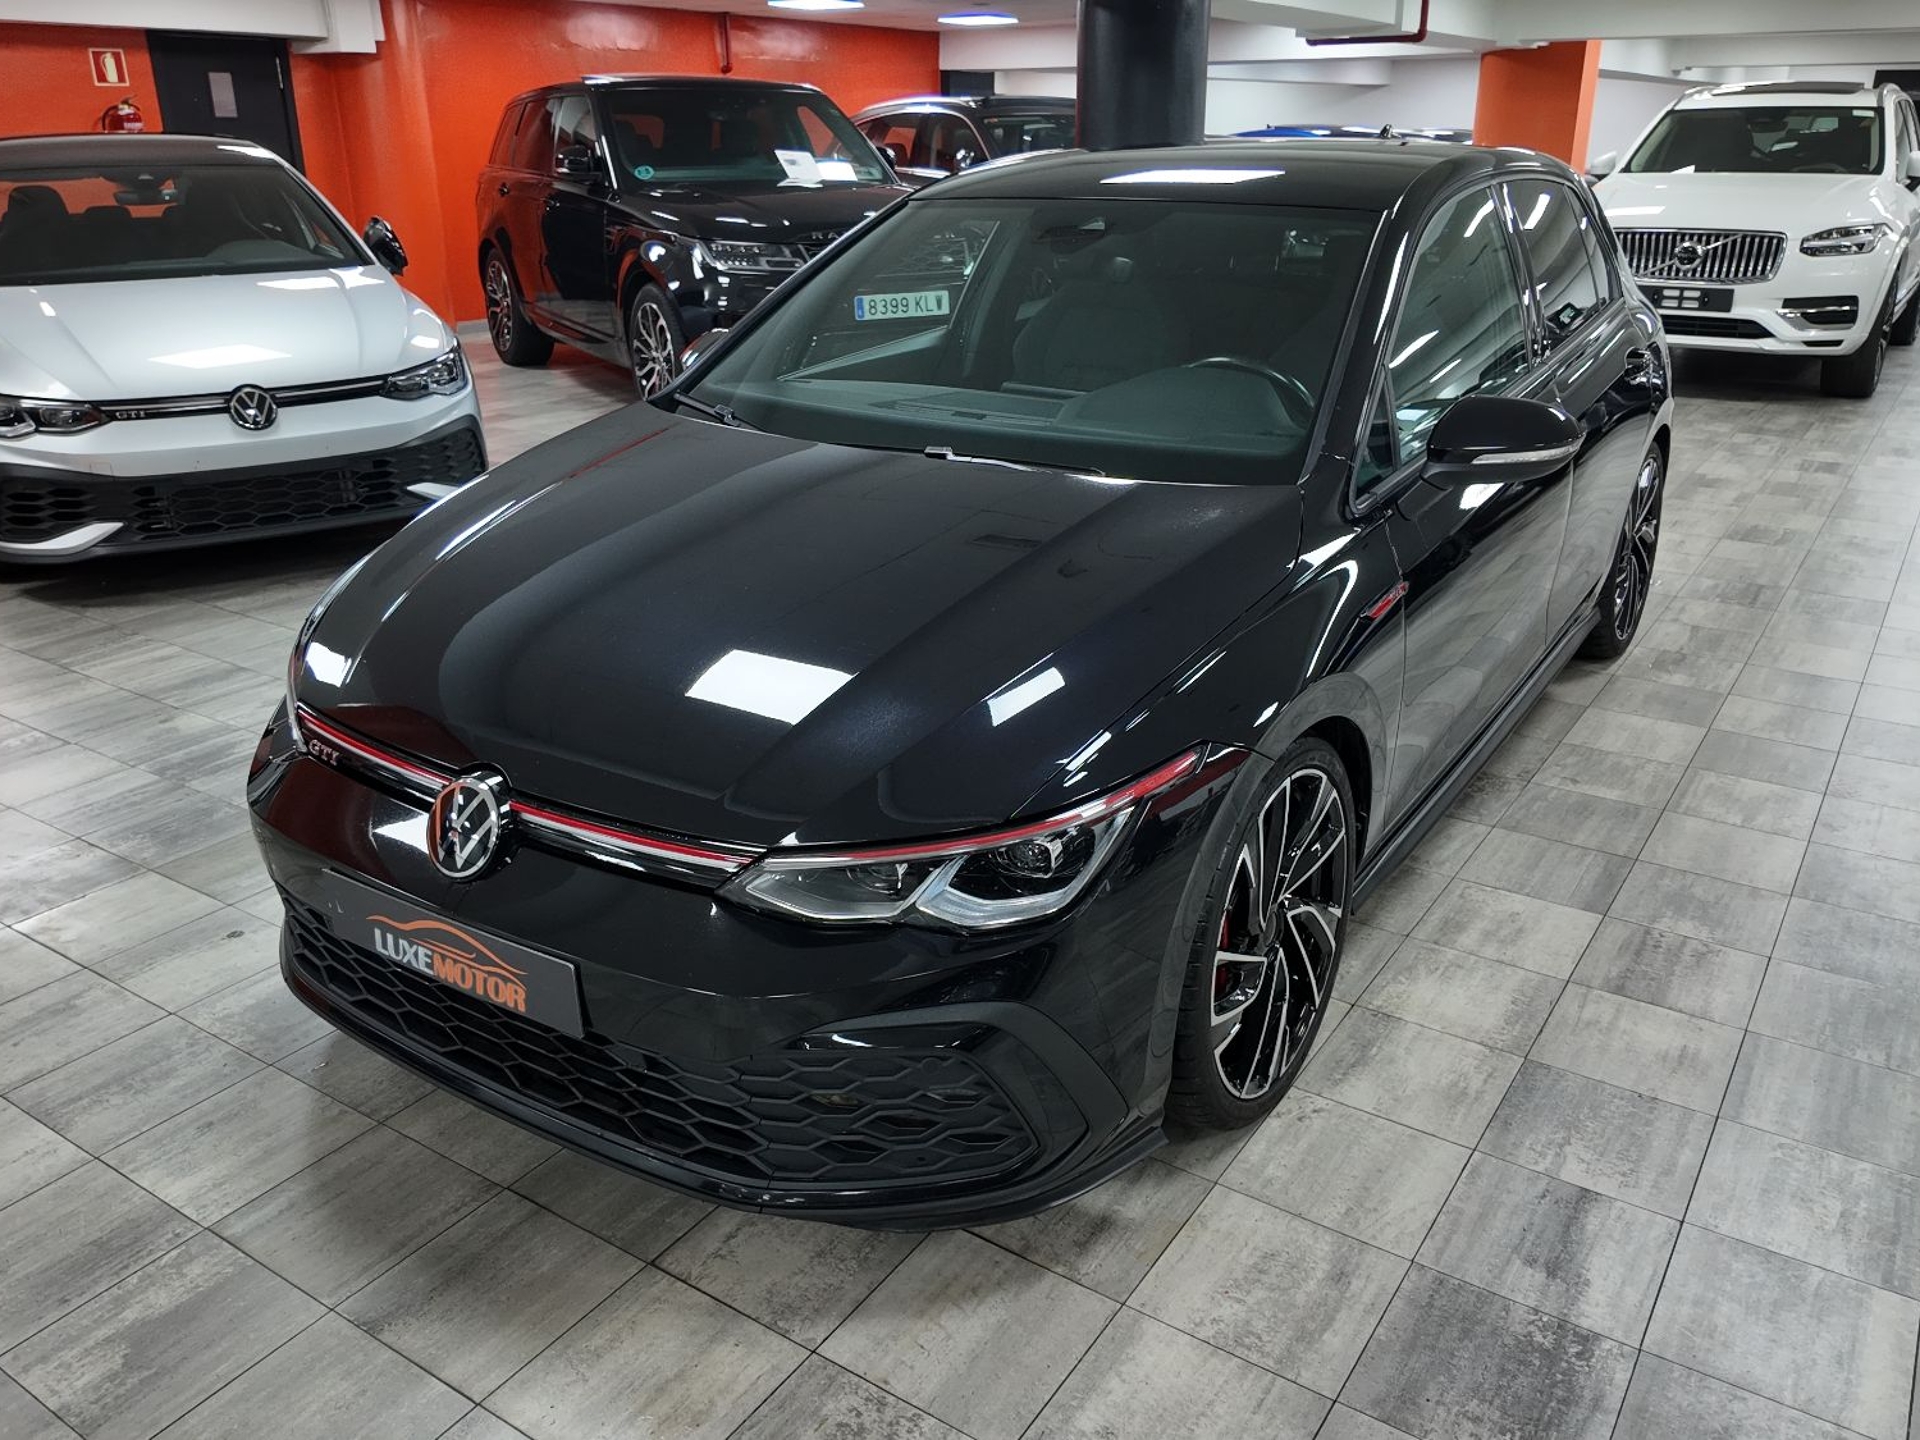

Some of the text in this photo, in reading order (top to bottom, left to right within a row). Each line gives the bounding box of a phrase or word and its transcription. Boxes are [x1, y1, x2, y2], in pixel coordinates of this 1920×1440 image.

[868, 297, 909, 315] 8399
[115, 410, 146, 419] GTI
[309, 740, 340, 766] GTI
[374, 926, 526, 1013] LUXEMOTOR
